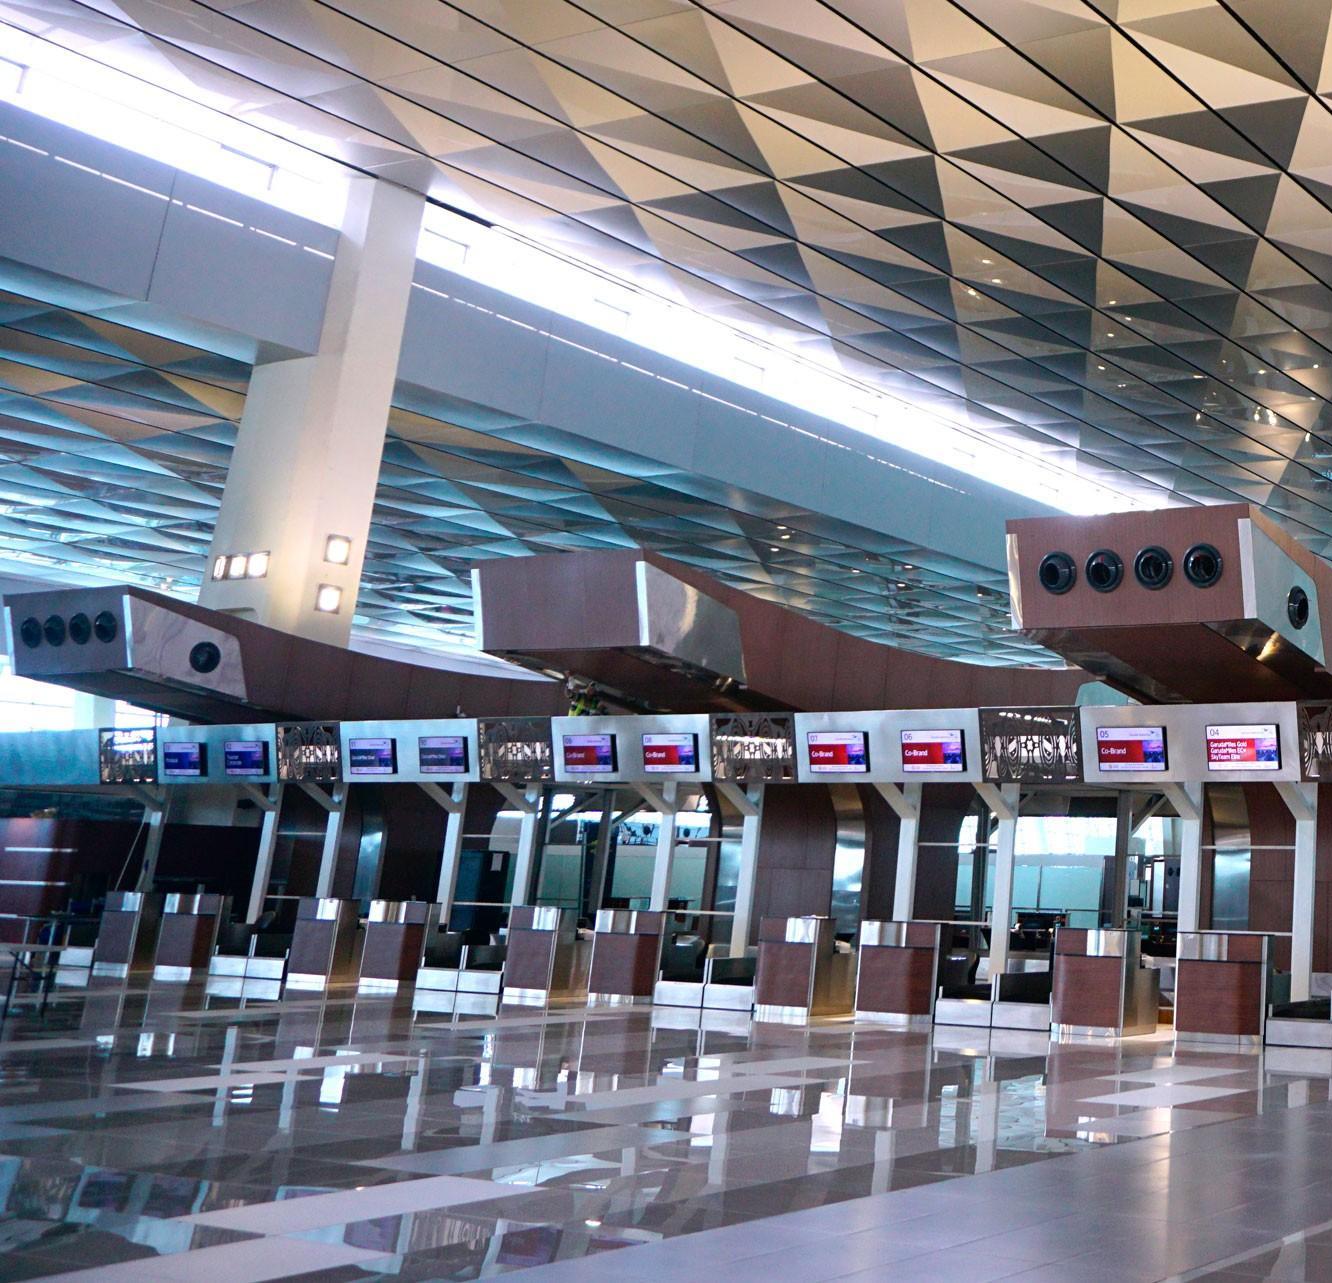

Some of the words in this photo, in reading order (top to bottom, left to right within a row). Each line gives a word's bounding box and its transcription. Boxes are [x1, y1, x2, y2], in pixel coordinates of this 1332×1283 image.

[1099, 730, 1109, 738] 05
[1209, 728, 1219, 736] 04
[904, 733, 912, 741] 06
